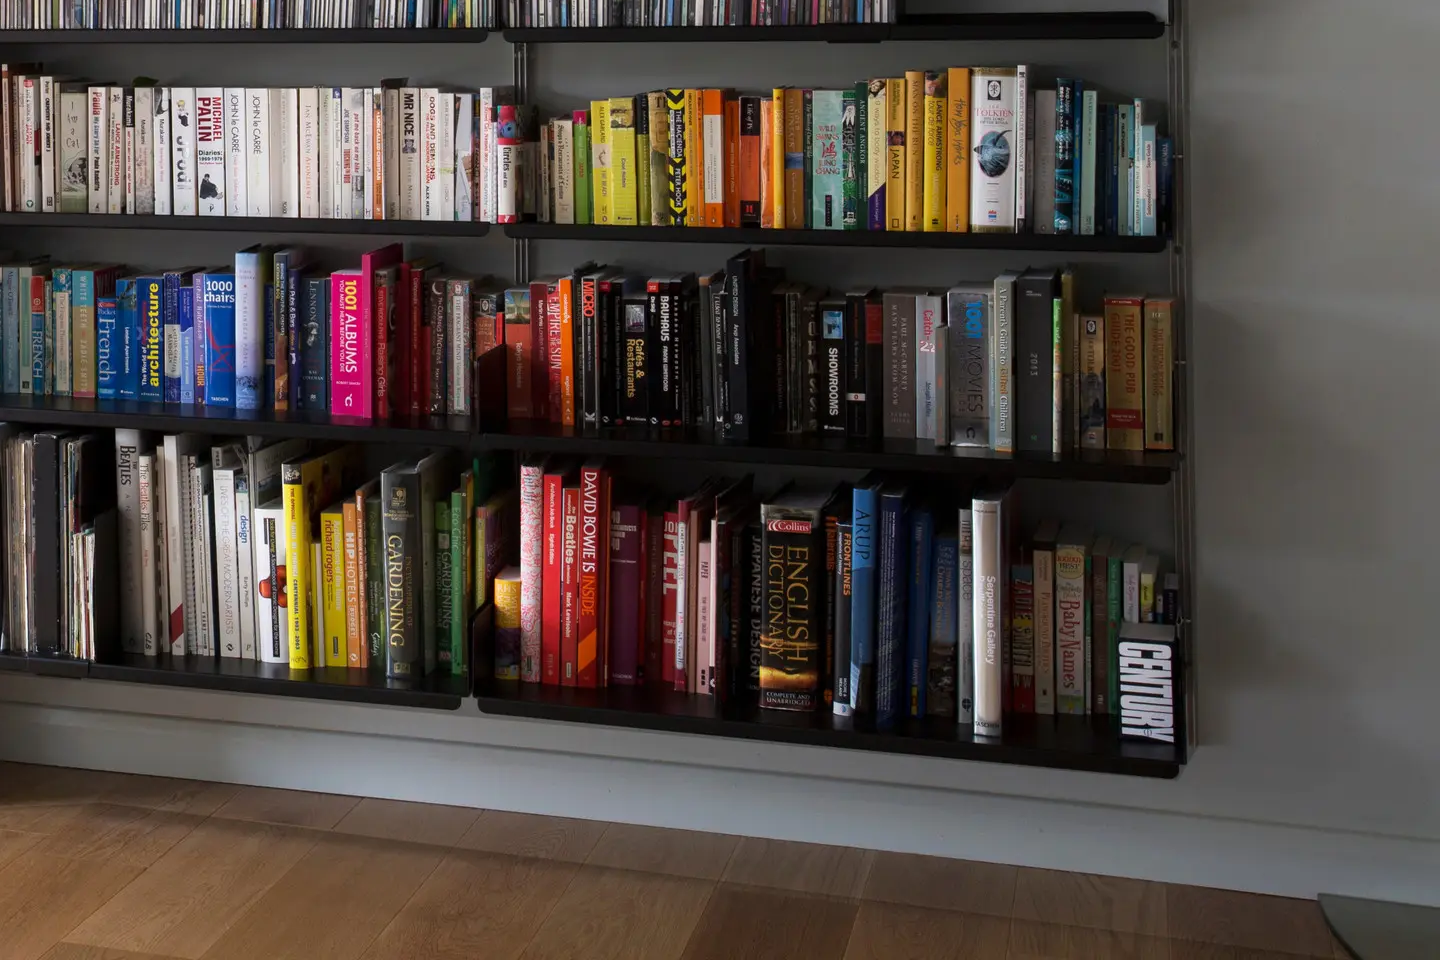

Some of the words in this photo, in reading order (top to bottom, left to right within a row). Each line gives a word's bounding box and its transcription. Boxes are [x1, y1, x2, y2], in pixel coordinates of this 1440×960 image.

[125, 95, 133, 126] Murakami
[230, 93, 240, 117] JOHN
[252, 95, 262, 119] JOHN
[404, 93, 414, 110] MR
[912, 101, 918, 114] ON
[955, 98, 966, 116] How
[158, 118, 166, 145] Murakami
[198, 96, 212, 142] PALIN
[212, 96, 222, 141] MICHAEL
[231, 118, 239, 126] le
[404, 112, 414, 136] NICE
[928, 116, 935, 126] de
[949, 119, 967, 137] Yoga
[231, 126, 241, 153] CARRÉ
[252, 128, 263, 155] CARRÉ
[953, 139, 966, 165] Works
[176, 136, 192, 183] JPod
[502, 147, 512, 171] Circles
[890, 149, 900, 179] JAPAN
[204, 292, 235, 303] chairs
[206, 281, 233, 291] 1000
[345, 280, 357, 310] 1001
[583, 281, 595, 317] MICRO
[309, 281, 320, 323] LENNON
[549, 296, 560, 336] EMPIRE
[999, 295, 1007, 327] Parent's
[660, 295, 670, 341] BAUHAUS
[965, 301, 983, 339] 1001
[1124, 313, 1135, 334] THE
[98, 318, 116, 381] French
[149, 283, 159, 387] architecture
[345, 313, 357, 373] ALBUMS
[999, 329, 1007, 354] Guide
[32, 331, 43, 378] FRENCH
[550, 347, 561, 369] SUN
[635, 339, 644, 367] Cafés
[999, 356, 1007, 365] to
[1125, 336, 1135, 368] GOOD
[196, 365, 205, 387] HOUR
[627, 339, 636, 398] Restaurants
[635, 369, 645, 378] &
[828, 347, 838, 416] SHOWROOMS
[967, 344, 984, 412] MOVIES
[999, 367, 1008, 394] Gifted
[1125, 372, 1135, 394] PUB
[999, 395, 1008, 432] Children
[118, 445, 137, 486] BEATLES
[140, 464, 150, 480] The
[140, 481, 150, 510] Beatles
[583, 471, 597, 513] DAVID
[140, 512, 151, 531] Files
[238, 515, 249, 544] design
[324, 519, 335, 552] richard
[776, 520, 810, 531] Collins
[855, 509, 872, 560] ARUP
[346, 532, 355, 560] HIP
[565, 515, 577, 564] Beatles
[582, 515, 596, 559] BOWIE
[325, 553, 334, 583] rogers
[582, 561, 595, 572] IS
[842, 533, 851, 596] FRONTLINES
[346, 561, 356, 603] HOTELS
[387, 535, 404, 647] GARDENING
[581, 575, 595, 616] INSIDE
[768, 545, 784, 660] DICTIONARY
[786, 545, 809, 662] ENGLISH
[985, 575, 996, 629] Serpentine
[564, 608, 572, 638] Lewisohn
[1059, 600, 1081, 636] Baby
[985, 630, 996, 665] Gallery
[1059, 639, 1081, 689] Names
[1118, 641, 1175, 743] CENTURY
